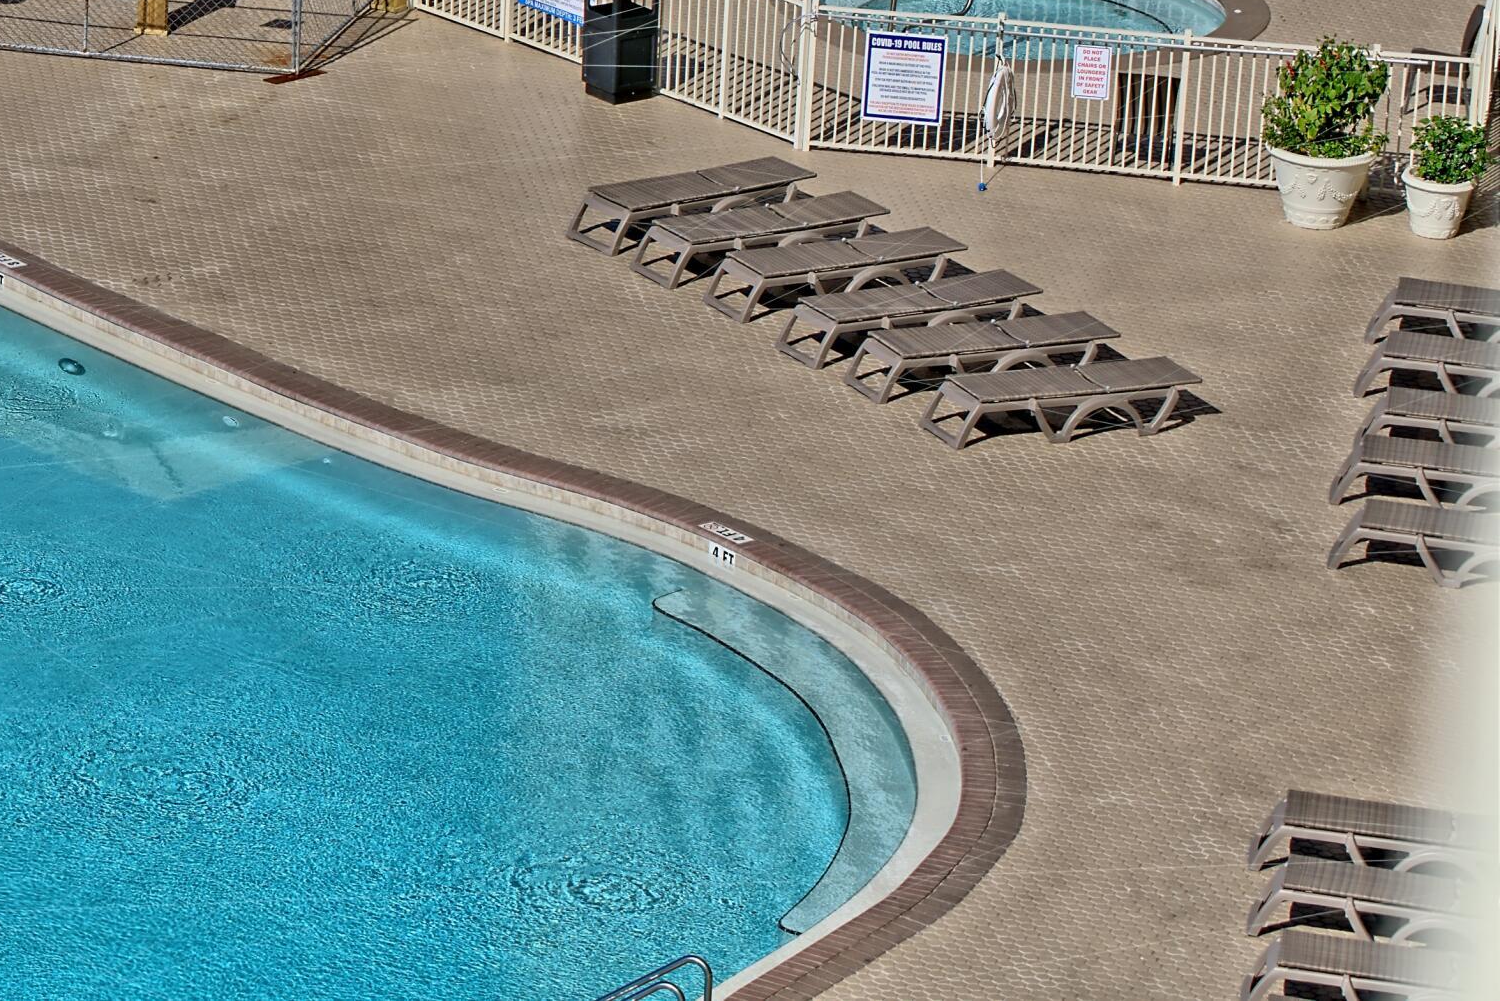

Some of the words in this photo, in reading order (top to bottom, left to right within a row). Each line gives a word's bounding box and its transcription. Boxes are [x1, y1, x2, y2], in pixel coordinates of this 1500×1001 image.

[534, 0, 555, 14] MAXIMUM
[556, 8, 572, 20] DEPTH:
[871, 38, 902, 48] COVID-19
[904, 40, 920, 50] POOL
[922, 42, 942, 51] RULES
[712, 546, 718, 558] 4
[722, 550, 734, 565] FT
